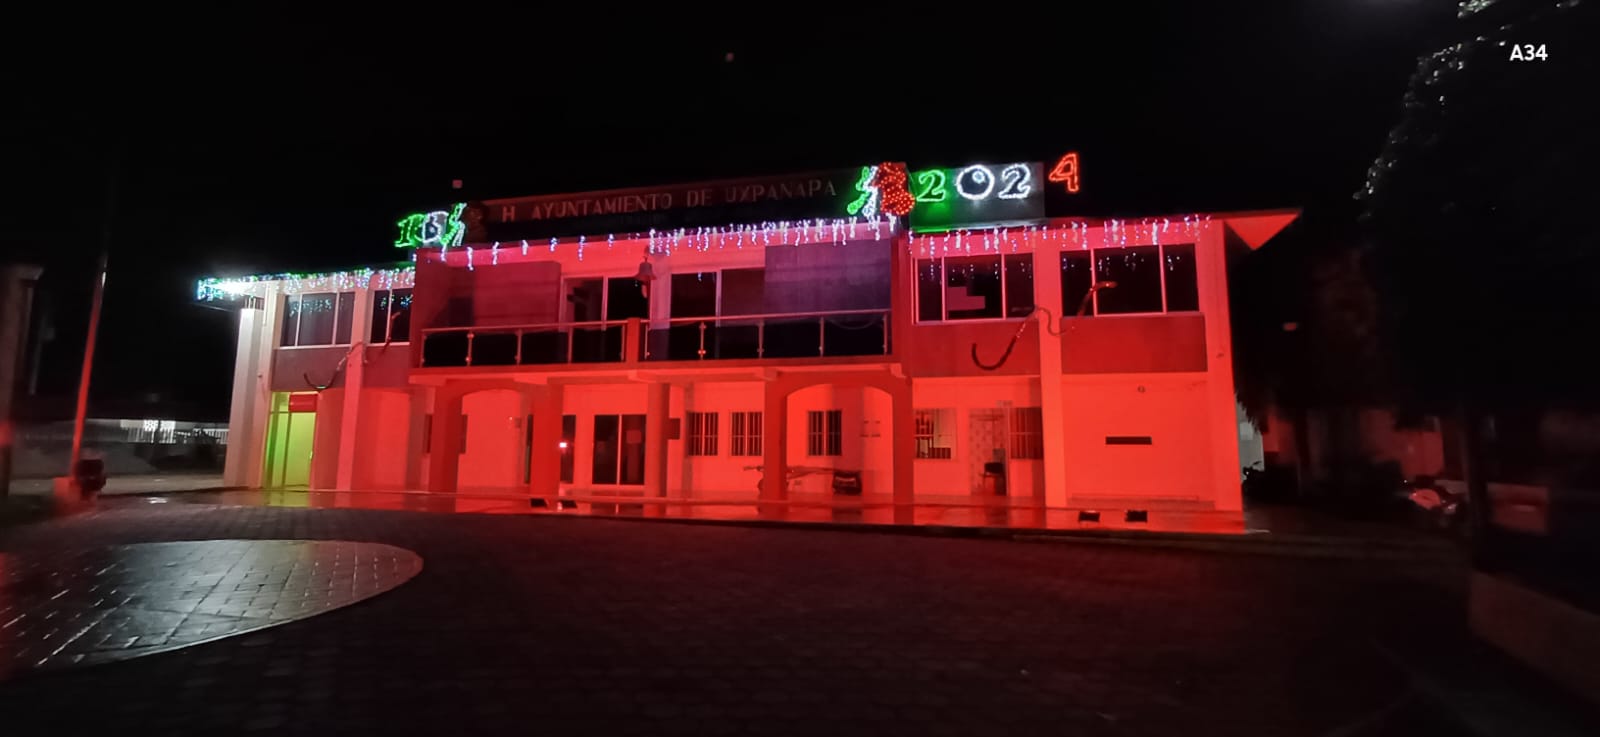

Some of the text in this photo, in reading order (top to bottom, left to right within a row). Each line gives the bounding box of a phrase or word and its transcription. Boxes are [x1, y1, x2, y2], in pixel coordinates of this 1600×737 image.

[532, 192, 673, 220] AYUNTAMIENTO
[686, 188, 713, 207] DE
[725, 178, 837, 203] UXPANAPA
